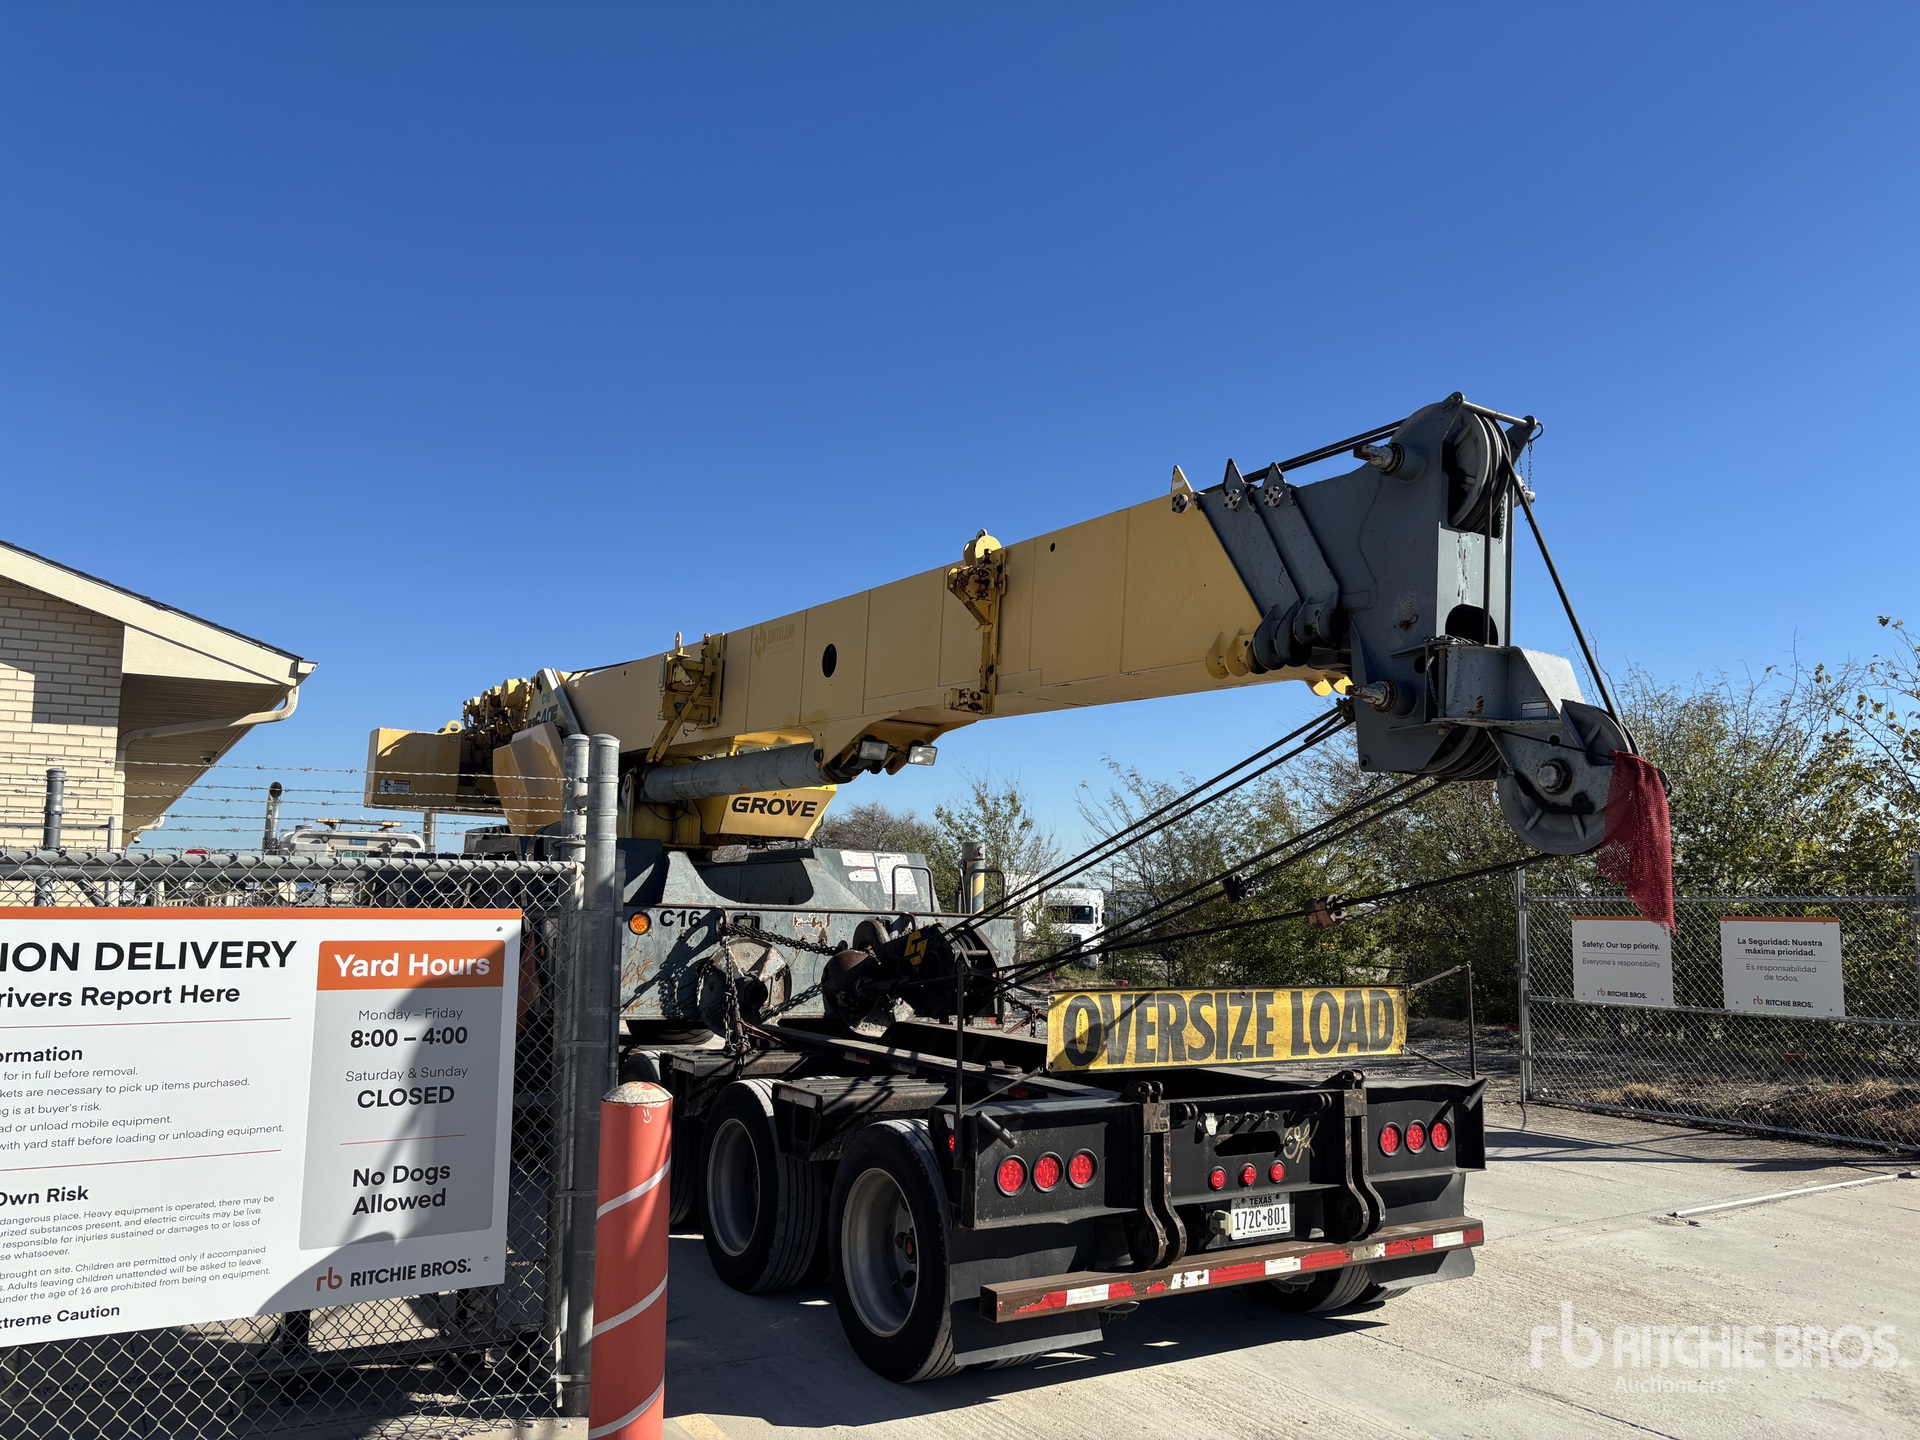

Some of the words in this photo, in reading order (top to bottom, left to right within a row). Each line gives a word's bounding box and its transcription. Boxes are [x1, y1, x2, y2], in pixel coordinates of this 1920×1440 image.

[732, 796, 818, 817] GROVE
[659, 910, 701, 927] C16
[1582, 941, 1605, 949] Safety:
[1606, 941, 1619, 949] Our
[1620, 942, 1632, 950] top
[1633, 942, 1660, 951] priority.
[1737, 937, 1746, 945] La
[1748, 937, 1790, 947] Seguridad:
[1792, 939, 1823, 947] Nuestra
[1745, 946, 1776, 955] máxima
[1777, 948, 1816, 957] prioridad.
[0, 941, 80, 972] ION
[94, 940, 297, 971] DELIVERY
[333, 953, 399, 977] Yard
[408, 953, 491, 976] Hours
[1745, 963, 1755, 971] Es
[1756, 965, 1817, 973] responsabilidad
[1764, 973, 1774, 981] de
[1775, 974, 1799, 982] todos.
[0, 986, 73, 1008] rivers
[81, 985, 172, 1010] Report
[180, 984, 240, 1004] Here
[1607, 990, 1629, 998] RITCHIE
[1765, 999, 1791, 1007] RITCHIE
[358, 1009, 411, 1022] Monday
[425, 1007, 463, 1020] Friday
[350, 1028, 398, 1049] 8:00
[422, 1026, 468, 1045] 4:00
[1063, 991, 1274, 1066] OVERSIZE
[1291, 989, 1395, 1056] LOAD
[3, 1072, 19, 1080] for
[22, 1071, 31, 1080] in
[35, 1070, 51, 1079] full
[54, 1069, 89, 1078] before
[92, 1066, 138, 1077] removal.
[345, 1069, 404, 1082] Saturday
[408, 1067, 417, 1079] &
[420, 1066, 468, 1079] Sunday
[0, 1089, 23, 1098] kets
[26, 1089, 44, 1097] are
[46, 1087, 103, 1096] necessary
[106, 1085, 116, 1093] to
[119, 1083, 142, 1094] pick
[144, 1083, 159, 1093] up
[162, 1082, 190, 1090] items
[192, 1077, 250, 1090] purchased.
[357, 1085, 455, 1109] CLOSED
[0, 1108, 9, 1117] g
[12, 1105, 21, 1115] is
[24, 1106, 35, 1114] at
[80, 1102, 102, 1112] risk.
[15, 1124, 27, 1132] or
[30, 1121, 68, 1131] unload
[71, 1119, 109, 1129] mobile
[111, 1115, 172, 1128] equipment.
[0, 1140, 20, 1150] with
[24, 1139, 48, 1151] yard
[51, 1137, 75, 1148] staff
[78, 1136, 113, 1146] before
[115, 1133, 156, 1143] loading
[158, 1133, 170, 1141] or
[172, 1129, 224, 1140] unloading
[227, 1124, 284, 1137] equipment.
[353, 1168, 385, 1187] No
[392, 1165, 451, 1185] Dogs
[46, 1185, 89, 1202] Risk
[352, 1188, 446, 1216] Allowed
[1250, 1195, 1272, 1205] TEXAS
[0, 1215, 51, 1226] dangerous
[53, 1212, 81, 1222] place.
[84, 1210, 112, 1219] Heavy
[114, 1205, 164, 1216] equipment
[166, 1204, 173, 1212] is
[175, 1200, 217, 1212] operated,
[219, 1199, 241, 1207] there
[243, 1197, 261, 1205] may
[263, 1195, 275, 1203] be
[29, 1223, 83, 1235] substances
[85, 1220, 122, 1231] present,
[124, 1217, 142, 1227] and
[143, 1215, 177, 1225] electric
[179, 1212, 210, 1222] circuits
[213, 1211, 231, 1219] may
[246, 1207, 263, 1215] live.
[2, 1236, 58, 1249] responsible
[60, 1235, 73, 1244] for
[75, 1232, 108, 1244] injuries
[110, 1228, 154, 1239] sustained
[167, 1224, 209, 1234] damages
[232, 1219, 250, 1228] loss
[0, 1269, 37, 1280] brought
[54, 1266, 73, 1274] site.
[75, 1262, 114, 1272] Children
[133, 1255, 177, 1268] permitted
[179, 1254, 198, 1263] only
[206, 1246, 266, 1259] accompanied
[14, 1248, 70, 1260] whatsoever.
[7, 1281, 38, 1291] Adults
[40, 1277, 74, 1287] leaving
[76, 1273, 114, 1284] children
[116, 1268, 167, 1279] unattended
[169, 1265, 184, 1274] will
[186, 1264, 198, 1272] be
[200, 1261, 226, 1271] asked
[239, 1258, 261, 1266] leave
[316, 1267, 343, 1292] rb
[350, 1265, 416, 1288] RITCHIE
[0, 1293, 28, 1303] under
[30, 1292, 45, 1300] the
[48, 1291, 66, 1299] age
[68, 1288, 78, 1296] of
[80, 1287, 91, 1295] 16
[110, 1280, 157, 1293] prohibited
[159, 1278, 179, 1287] from
[181, 1275, 206, 1285] being
[222, 1268, 270, 1280] equipment.
[0, 1312, 52, 1329] treme
[57, 1305, 120, 1322] Caution
